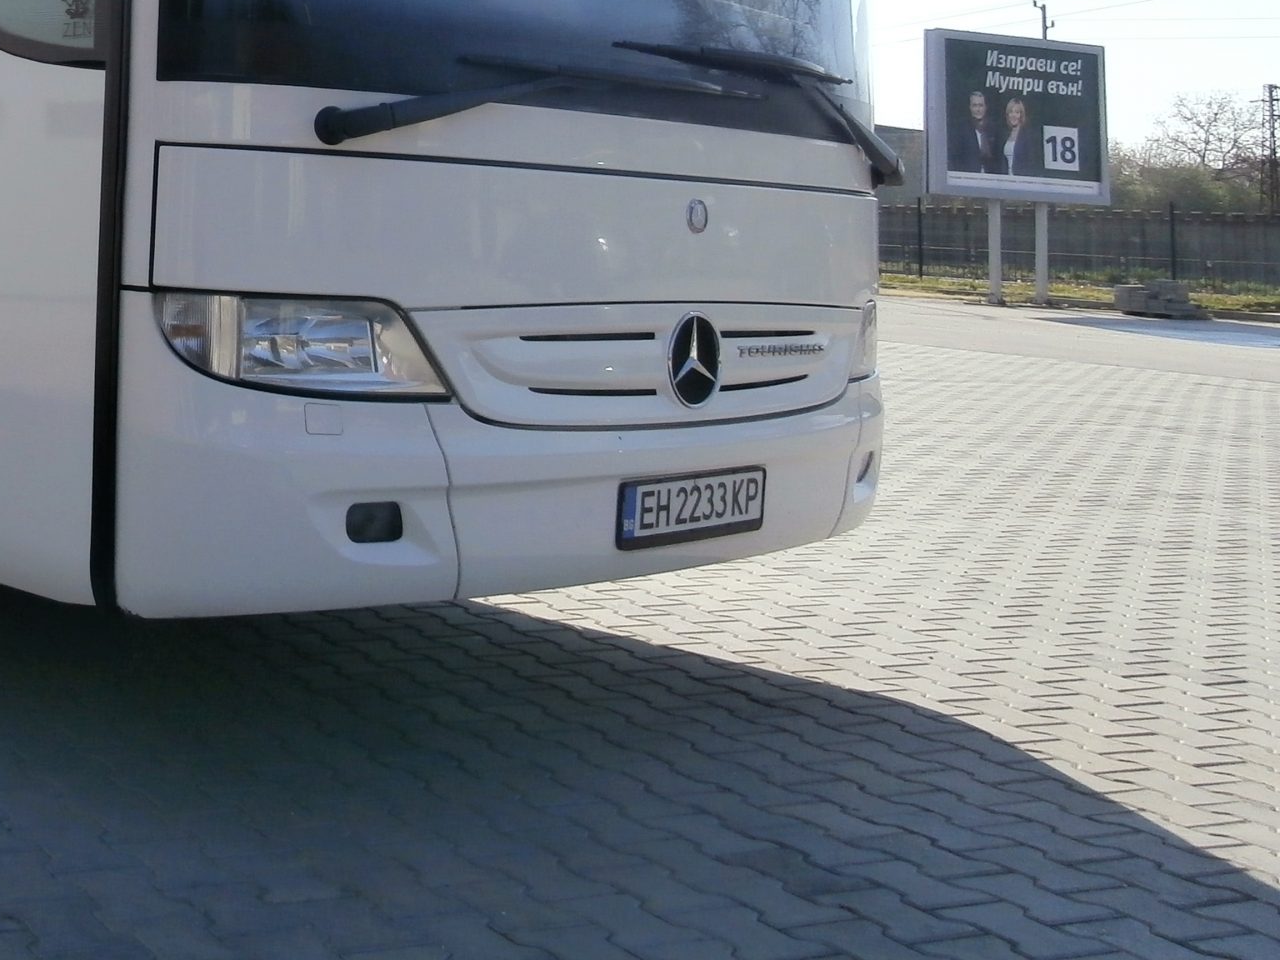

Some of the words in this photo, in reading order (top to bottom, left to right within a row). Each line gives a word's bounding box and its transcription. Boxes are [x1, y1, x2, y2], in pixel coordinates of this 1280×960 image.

[986, 50, 1056, 74] Изправи
[1060, 60, 1082, 76] се!
[985, 71, 1043, 95] Мутри
[1047, 80, 1083, 97] вън!
[1046, 135, 1076, 164] 18
